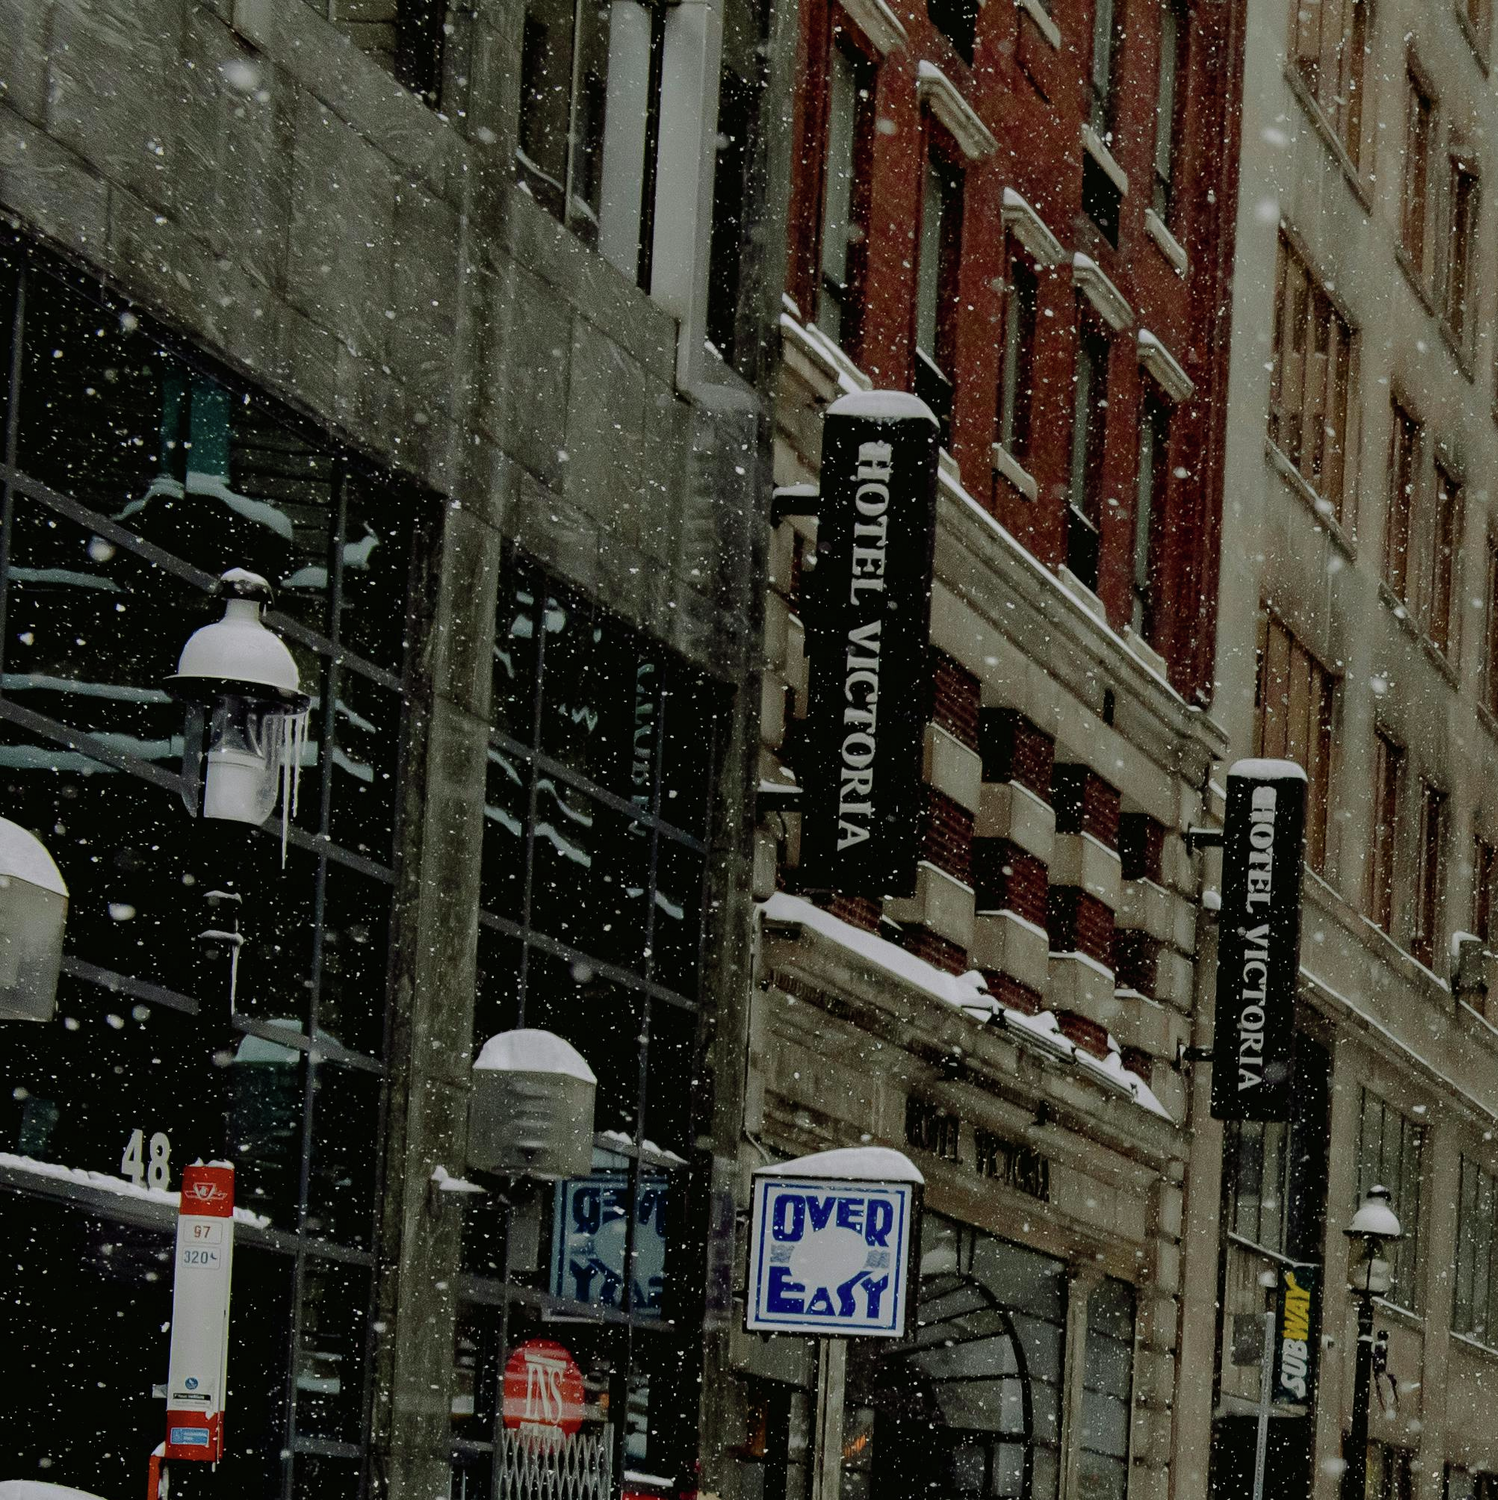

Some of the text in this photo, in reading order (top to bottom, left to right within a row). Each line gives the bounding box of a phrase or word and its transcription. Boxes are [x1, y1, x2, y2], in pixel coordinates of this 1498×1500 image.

[837, 441, 892, 852] HOTEL VICTORIA
[1237, 786, 1278, 1092] HOTEL VICTORIA
[121, 1128, 170, 1191] 48
[772, 1194, 894, 1248] OVER
[183, 1251, 208, 1264] 320
[766, 1265, 889, 1319] EASY
[1281, 1271, 1311, 1400] SUBWAY
